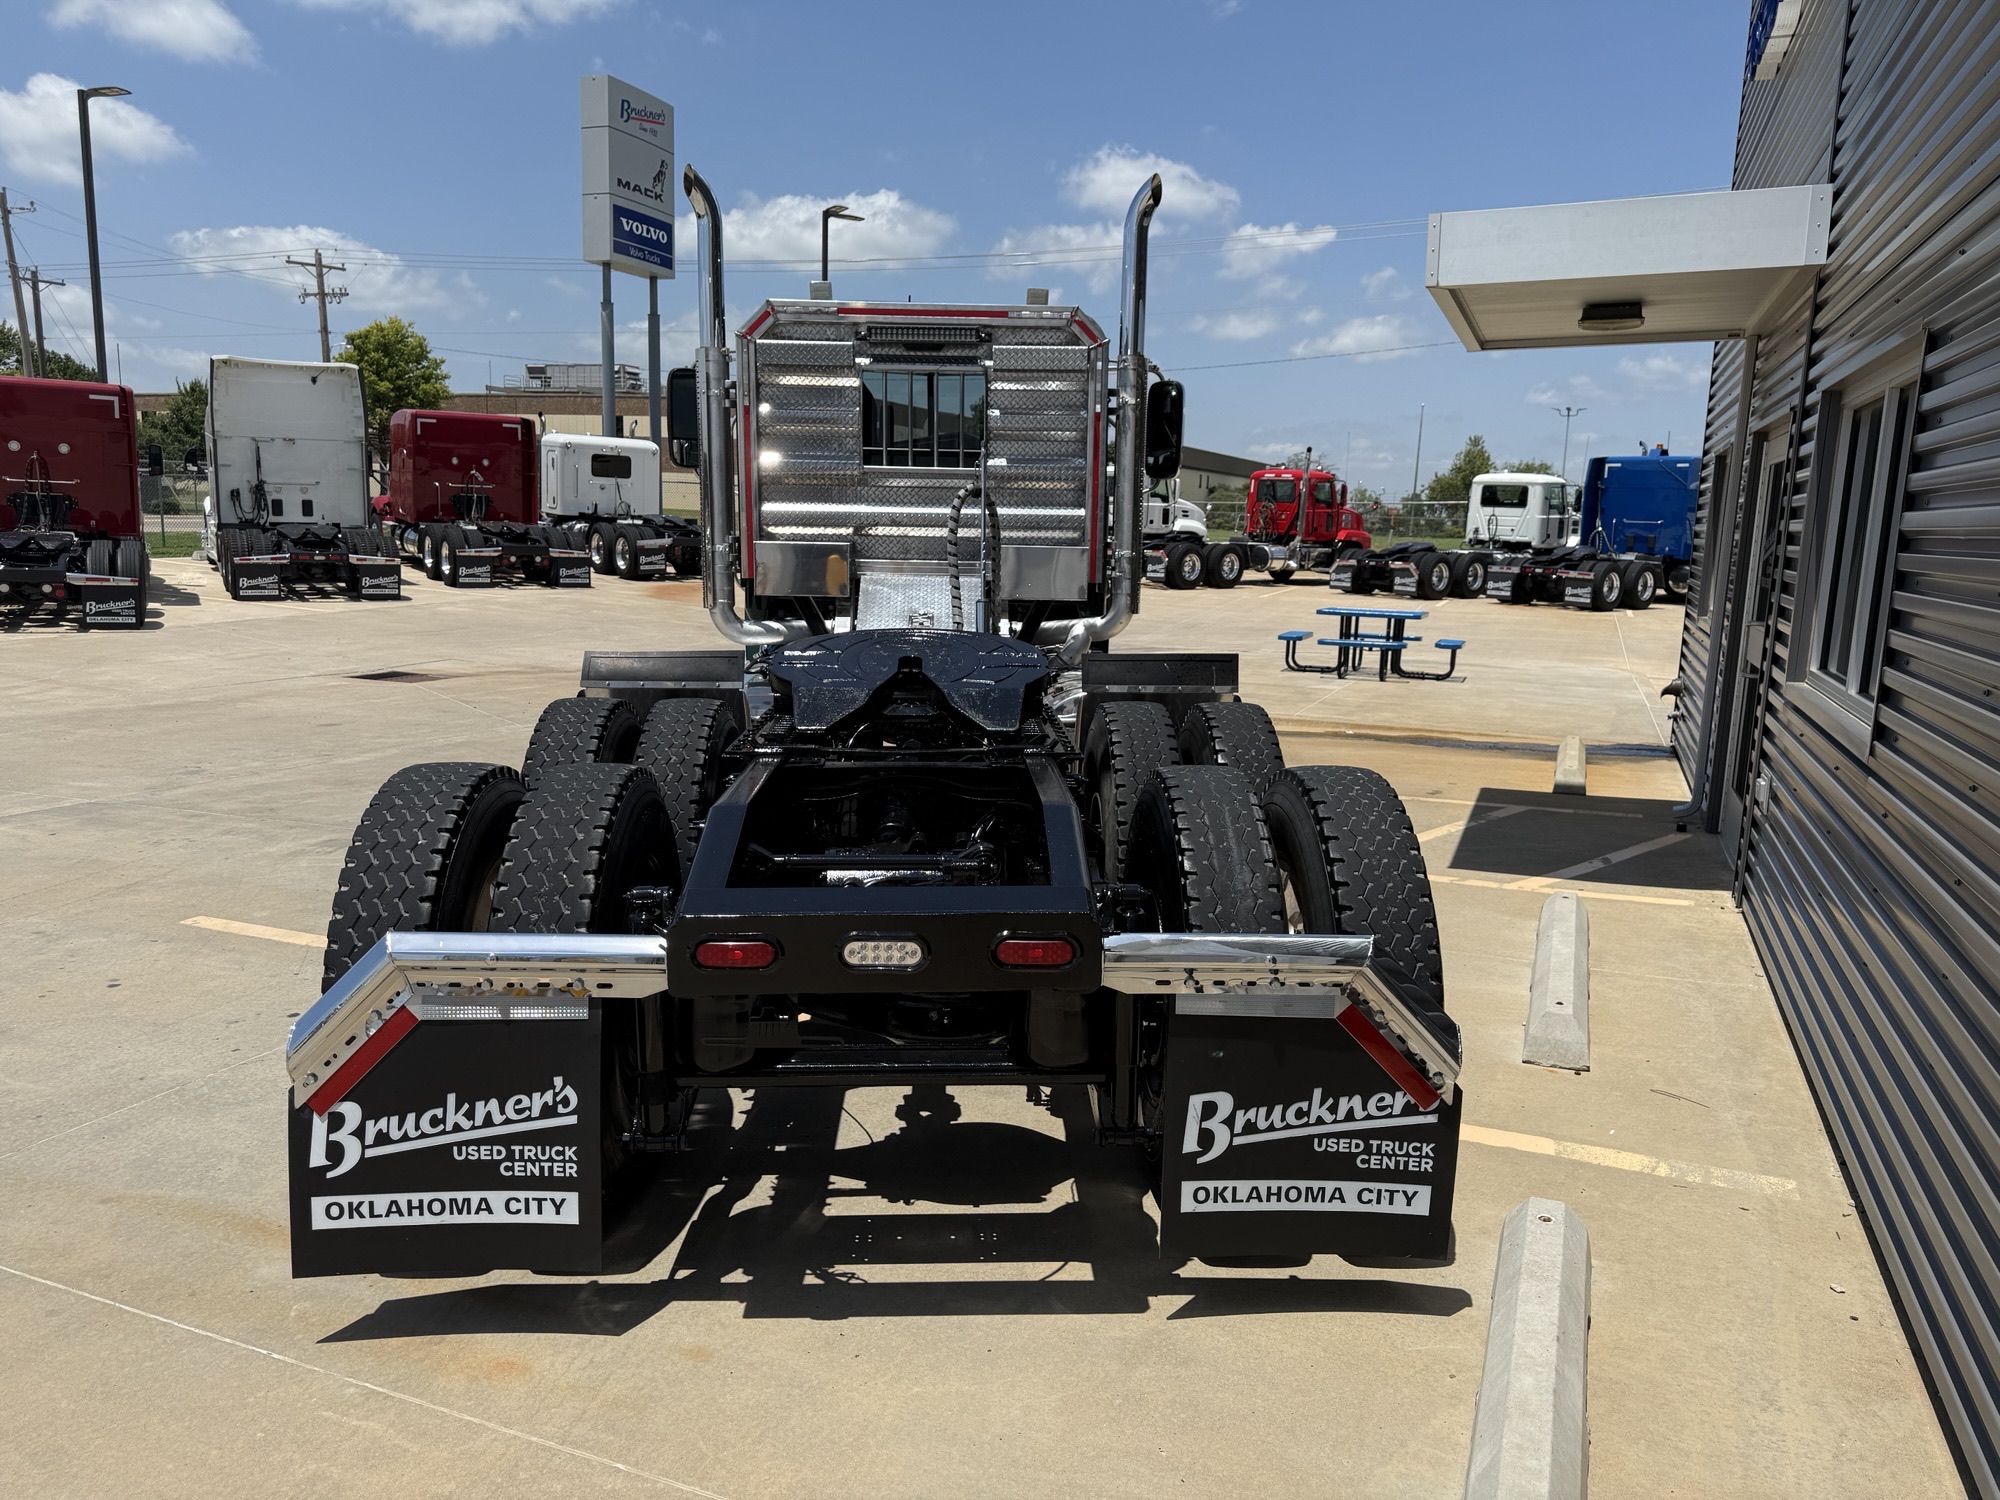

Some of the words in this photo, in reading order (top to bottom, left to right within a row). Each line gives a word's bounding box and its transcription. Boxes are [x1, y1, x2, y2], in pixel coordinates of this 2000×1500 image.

[620, 99, 666, 123] Bruckner's
[617, 177, 664, 203] MACK
[620, 217, 668, 244] VOLVO
[629, 246, 644, 259] Volvo
[644, 251, 660, 264] Trucks
[86, 598, 135, 614] Bruckner's
[309, 1076, 578, 1179] Bruckner's
[453, 1145, 506, 1161] USED
[510, 1145, 578, 1161] TRUCK
[1313, 1138, 1364, 1153] USED
[1369, 1139, 1436, 1157] TRUCK
[500, 1162, 578, 1177] CENTER
[1356, 1155, 1434, 1172] CENTER
[1192, 1185, 1347, 1205] OKLAHOMA
[1357, 1187, 1420, 1207] CITY
[324, 1196, 494, 1221] OKLAHOMA
[504, 1197, 567, 1216] CITY
